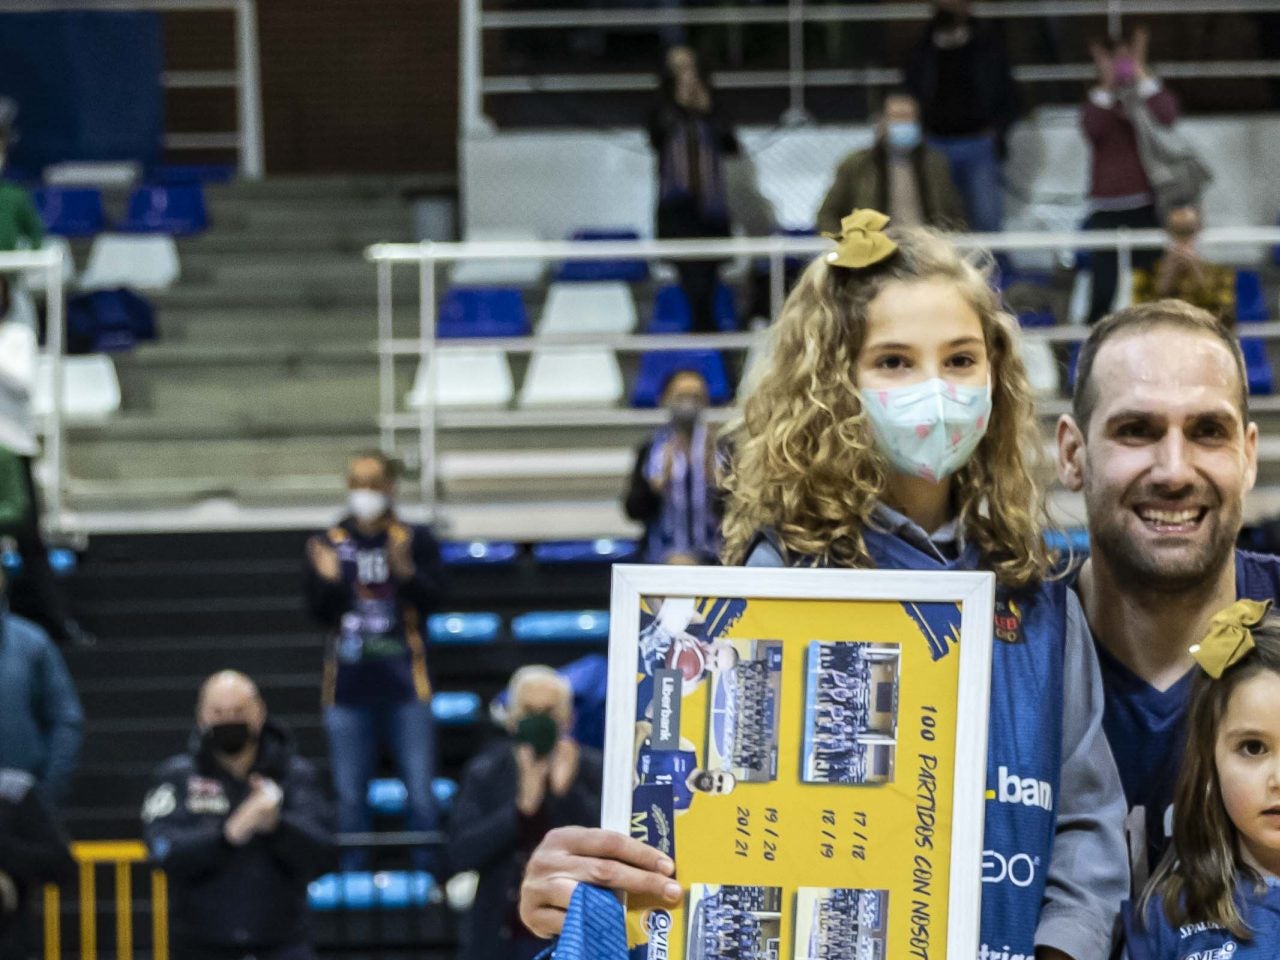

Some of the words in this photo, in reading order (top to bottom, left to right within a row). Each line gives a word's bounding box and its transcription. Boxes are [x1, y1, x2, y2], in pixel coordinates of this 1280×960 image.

[660, 677, 675, 741] Liberbank
[920, 705, 938, 742] 100
[914, 753, 938, 851] PARTIDOS
[998, 765, 1053, 811] ban
[912, 855, 933, 896] CON
